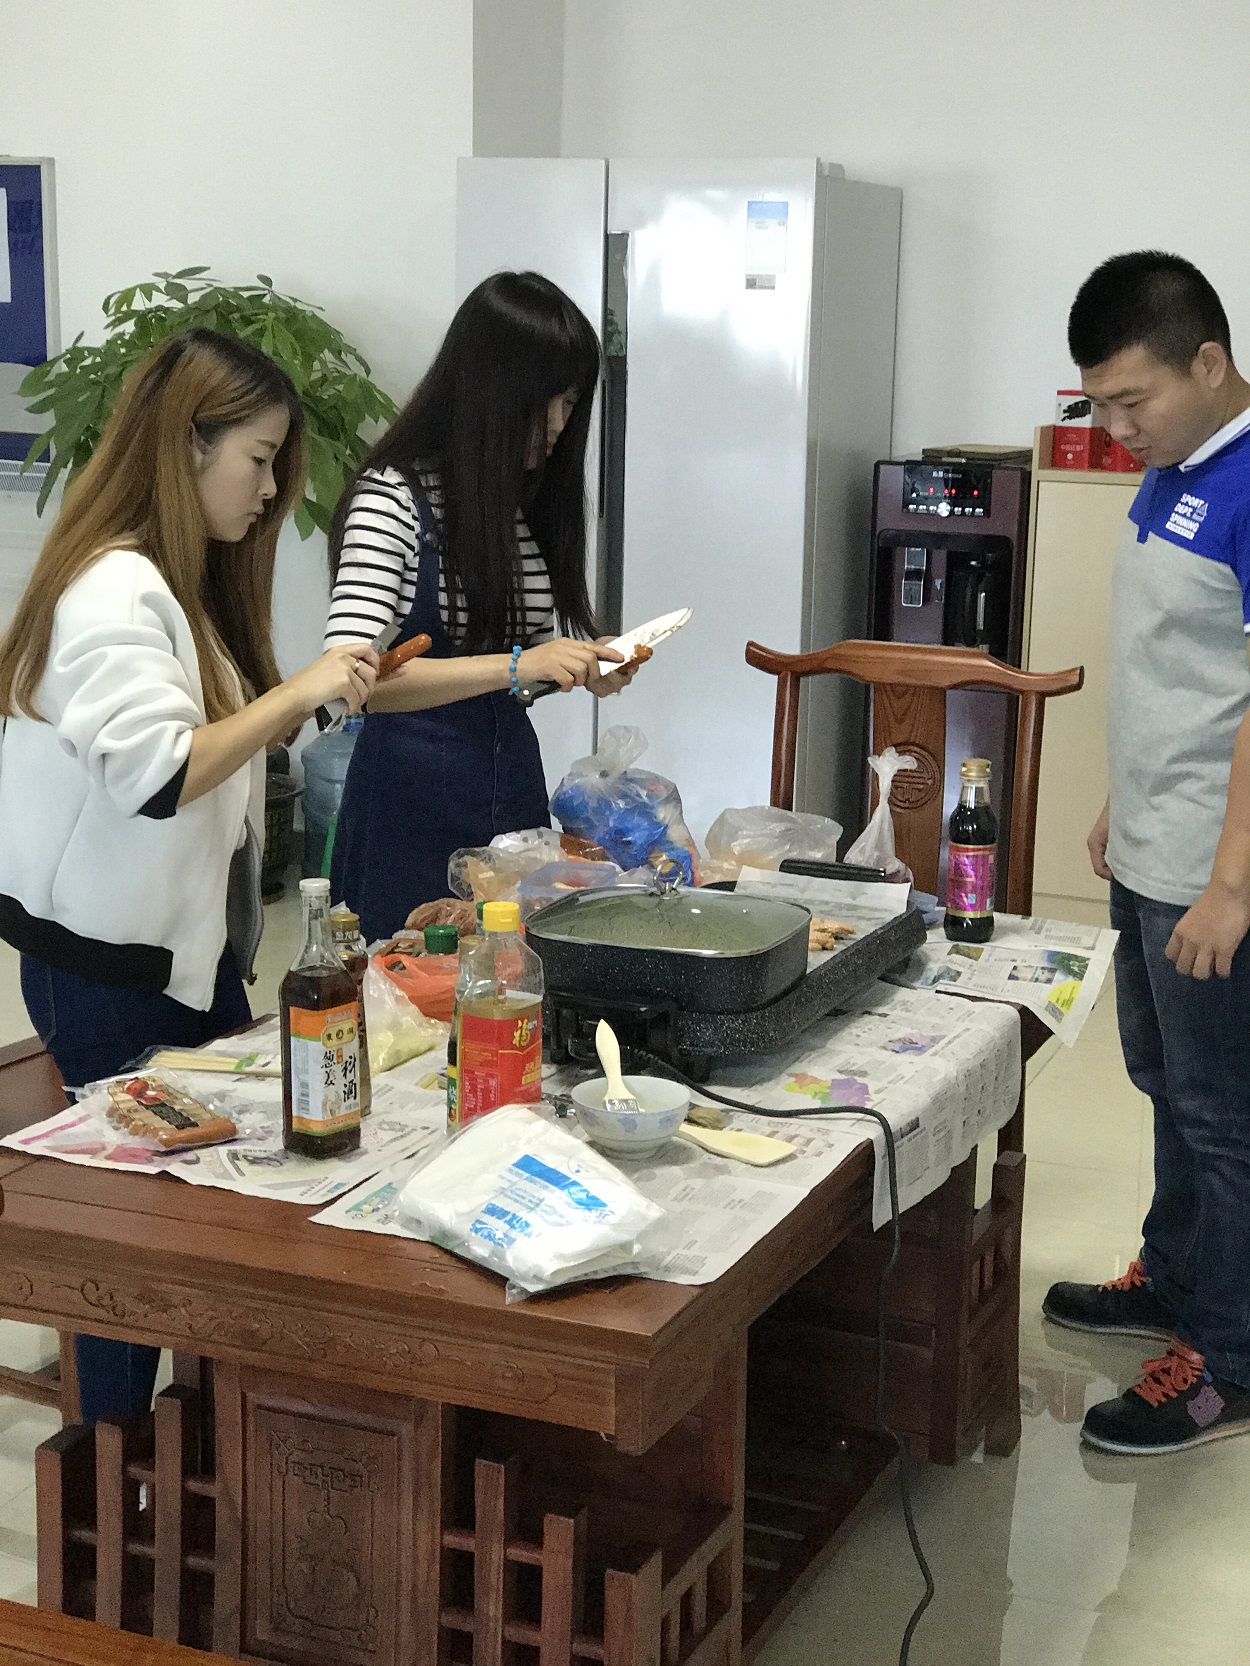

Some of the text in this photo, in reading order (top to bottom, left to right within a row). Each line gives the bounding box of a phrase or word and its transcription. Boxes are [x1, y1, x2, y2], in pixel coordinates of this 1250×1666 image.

[1180, 493, 1205, 508] SPORT
[1169, 512, 1200, 534] SPINNING
[341, 1052, 358, 1103] 料酒
